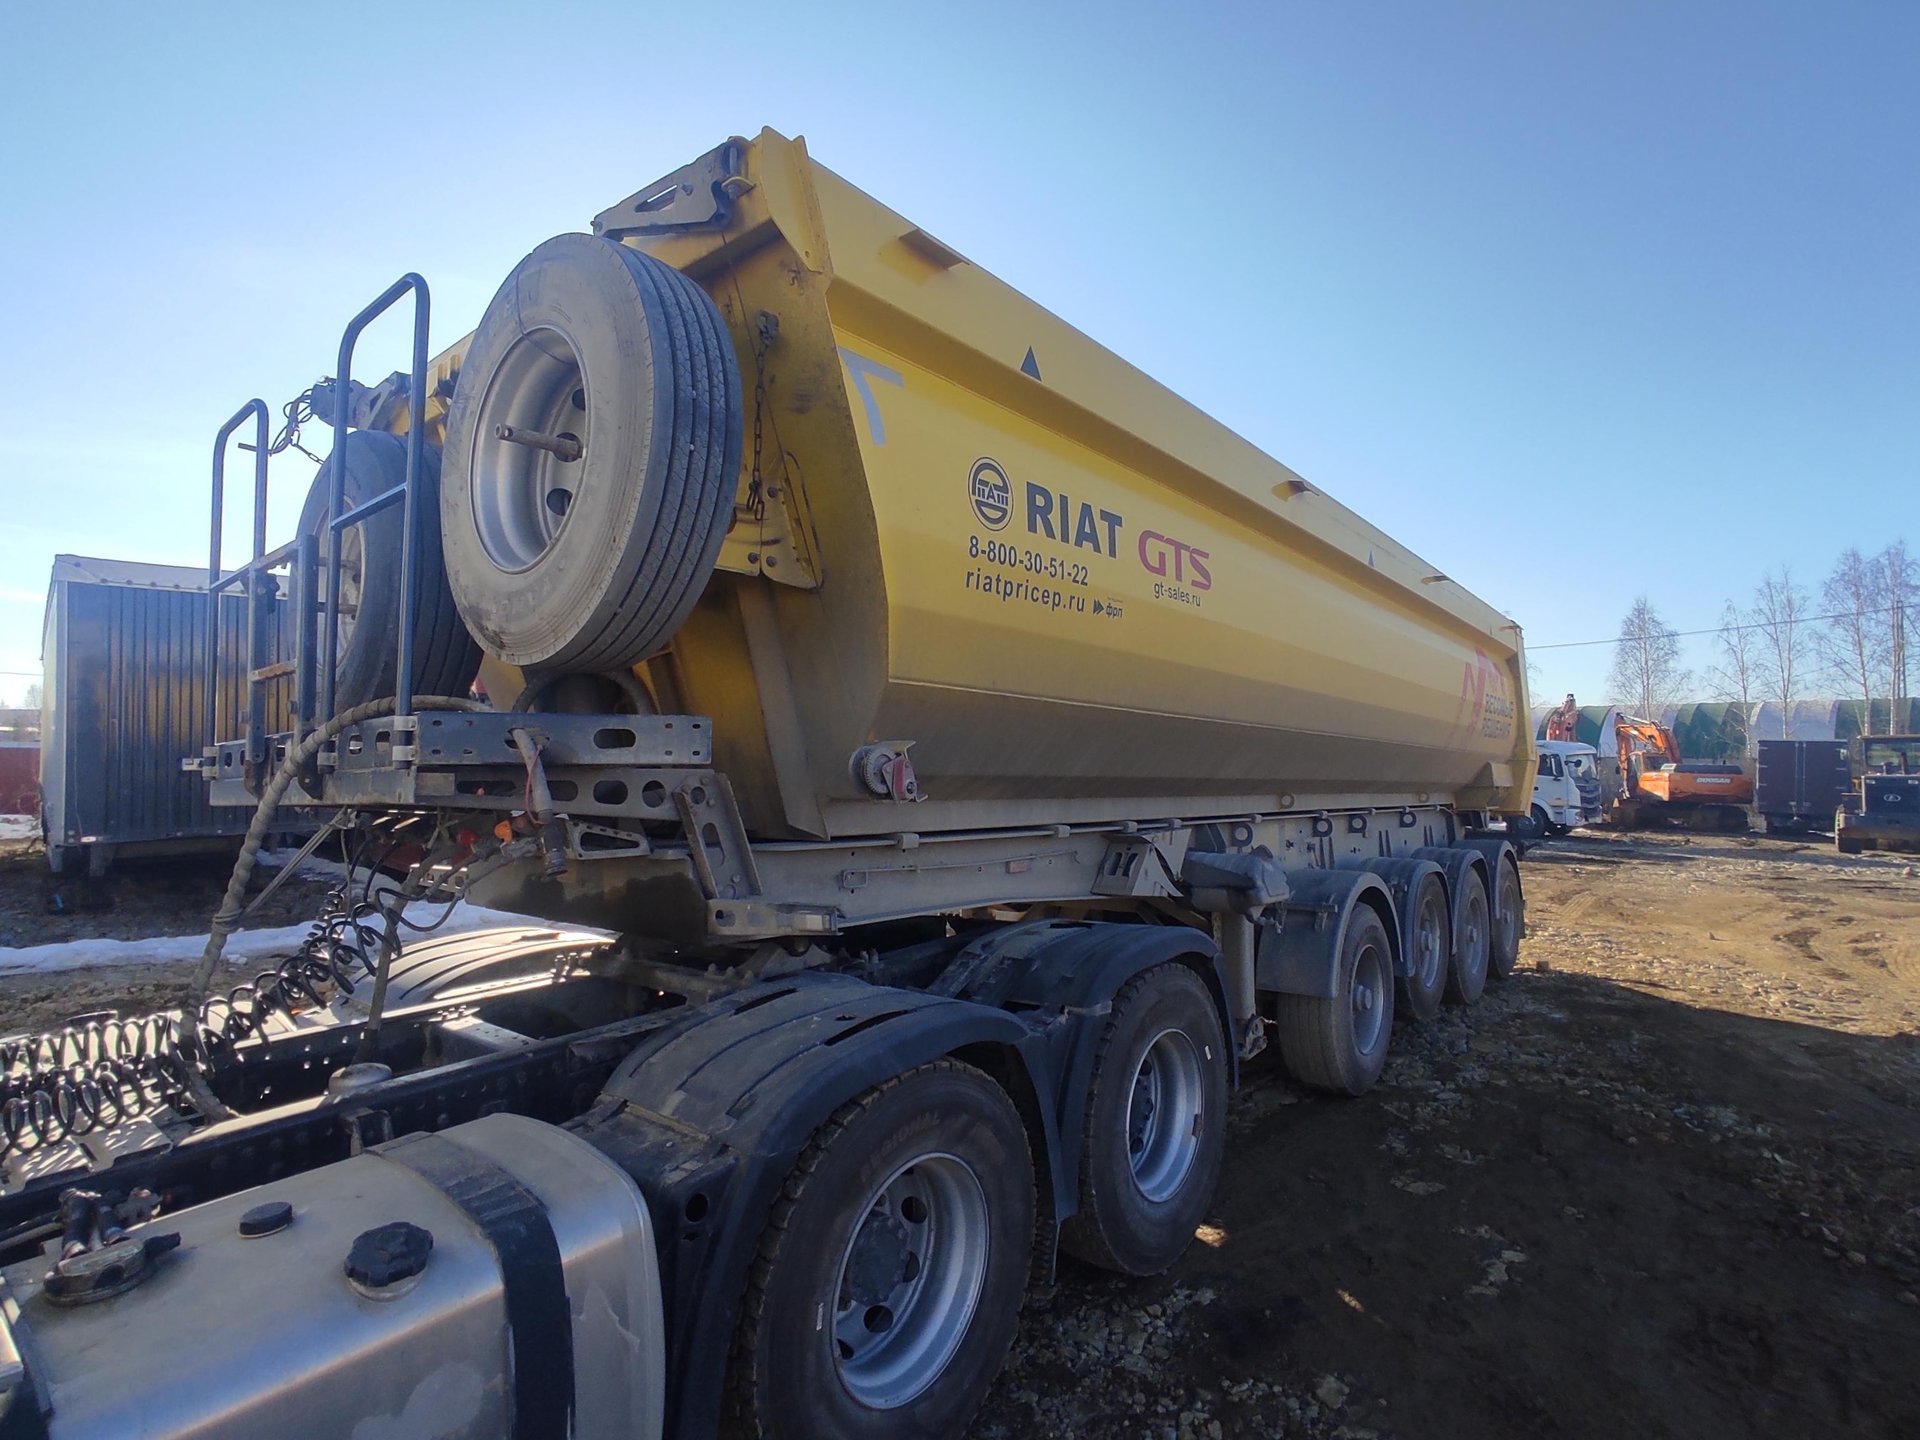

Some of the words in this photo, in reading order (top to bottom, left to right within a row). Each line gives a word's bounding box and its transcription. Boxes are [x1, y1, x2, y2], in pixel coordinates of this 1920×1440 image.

[1026, 481, 1123, 559] RIAT
[969, 535, 1089, 587] 8-800-30-51-22
[1138, 529, 1212, 591] GTS
[965, 569, 1086, 613] riatpricep.ru
[1153, 581, 1201, 608] gt-sales.ru
